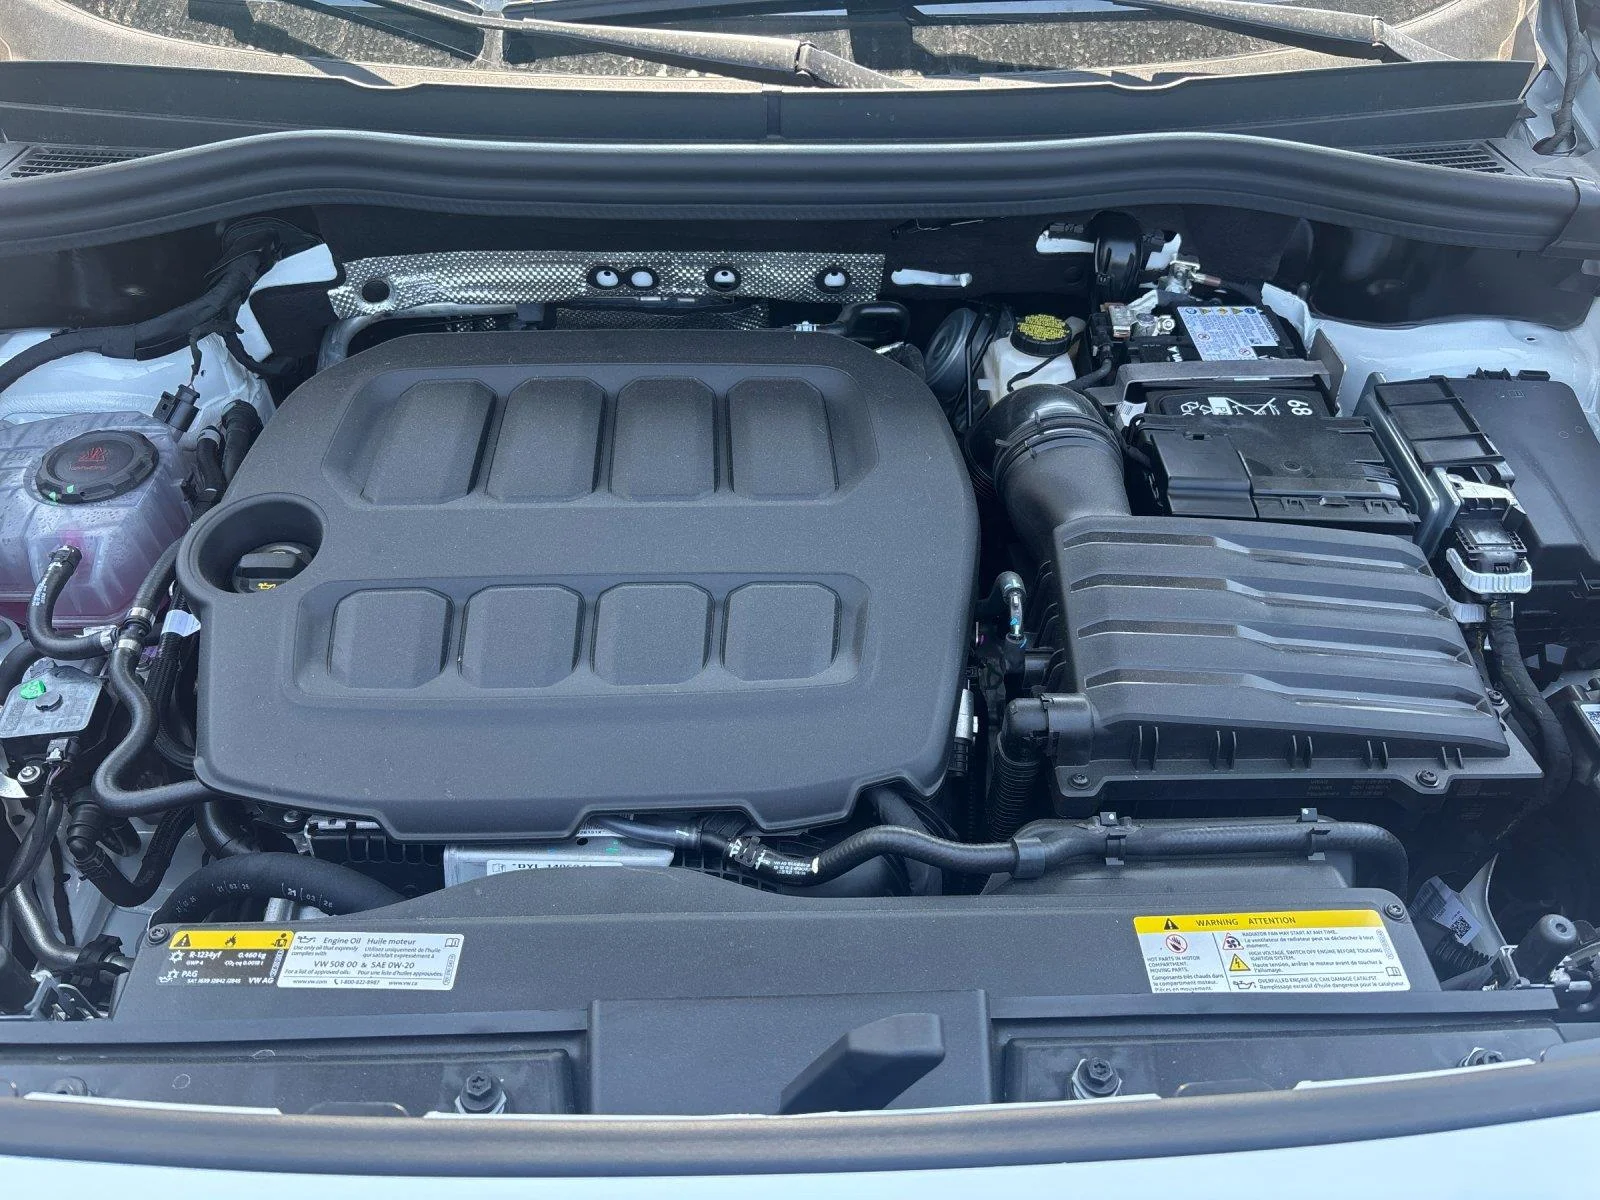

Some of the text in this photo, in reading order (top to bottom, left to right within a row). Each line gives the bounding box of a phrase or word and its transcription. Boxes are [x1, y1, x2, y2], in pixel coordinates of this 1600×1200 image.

[1195, 916, 1296, 927] WARNING ATTENTION
[323, 937, 361, 945] Engine Oil
[189, 950, 222, 959] R-1234yf
[257, 952, 267, 960] kg
[314, 960, 329, 968] VW
[329, 960, 345, 968] 508
[371, 961, 387, 969] SAE
[181, 970, 199, 978] PAG
[1159, 980, 1196, 988] compartiment
